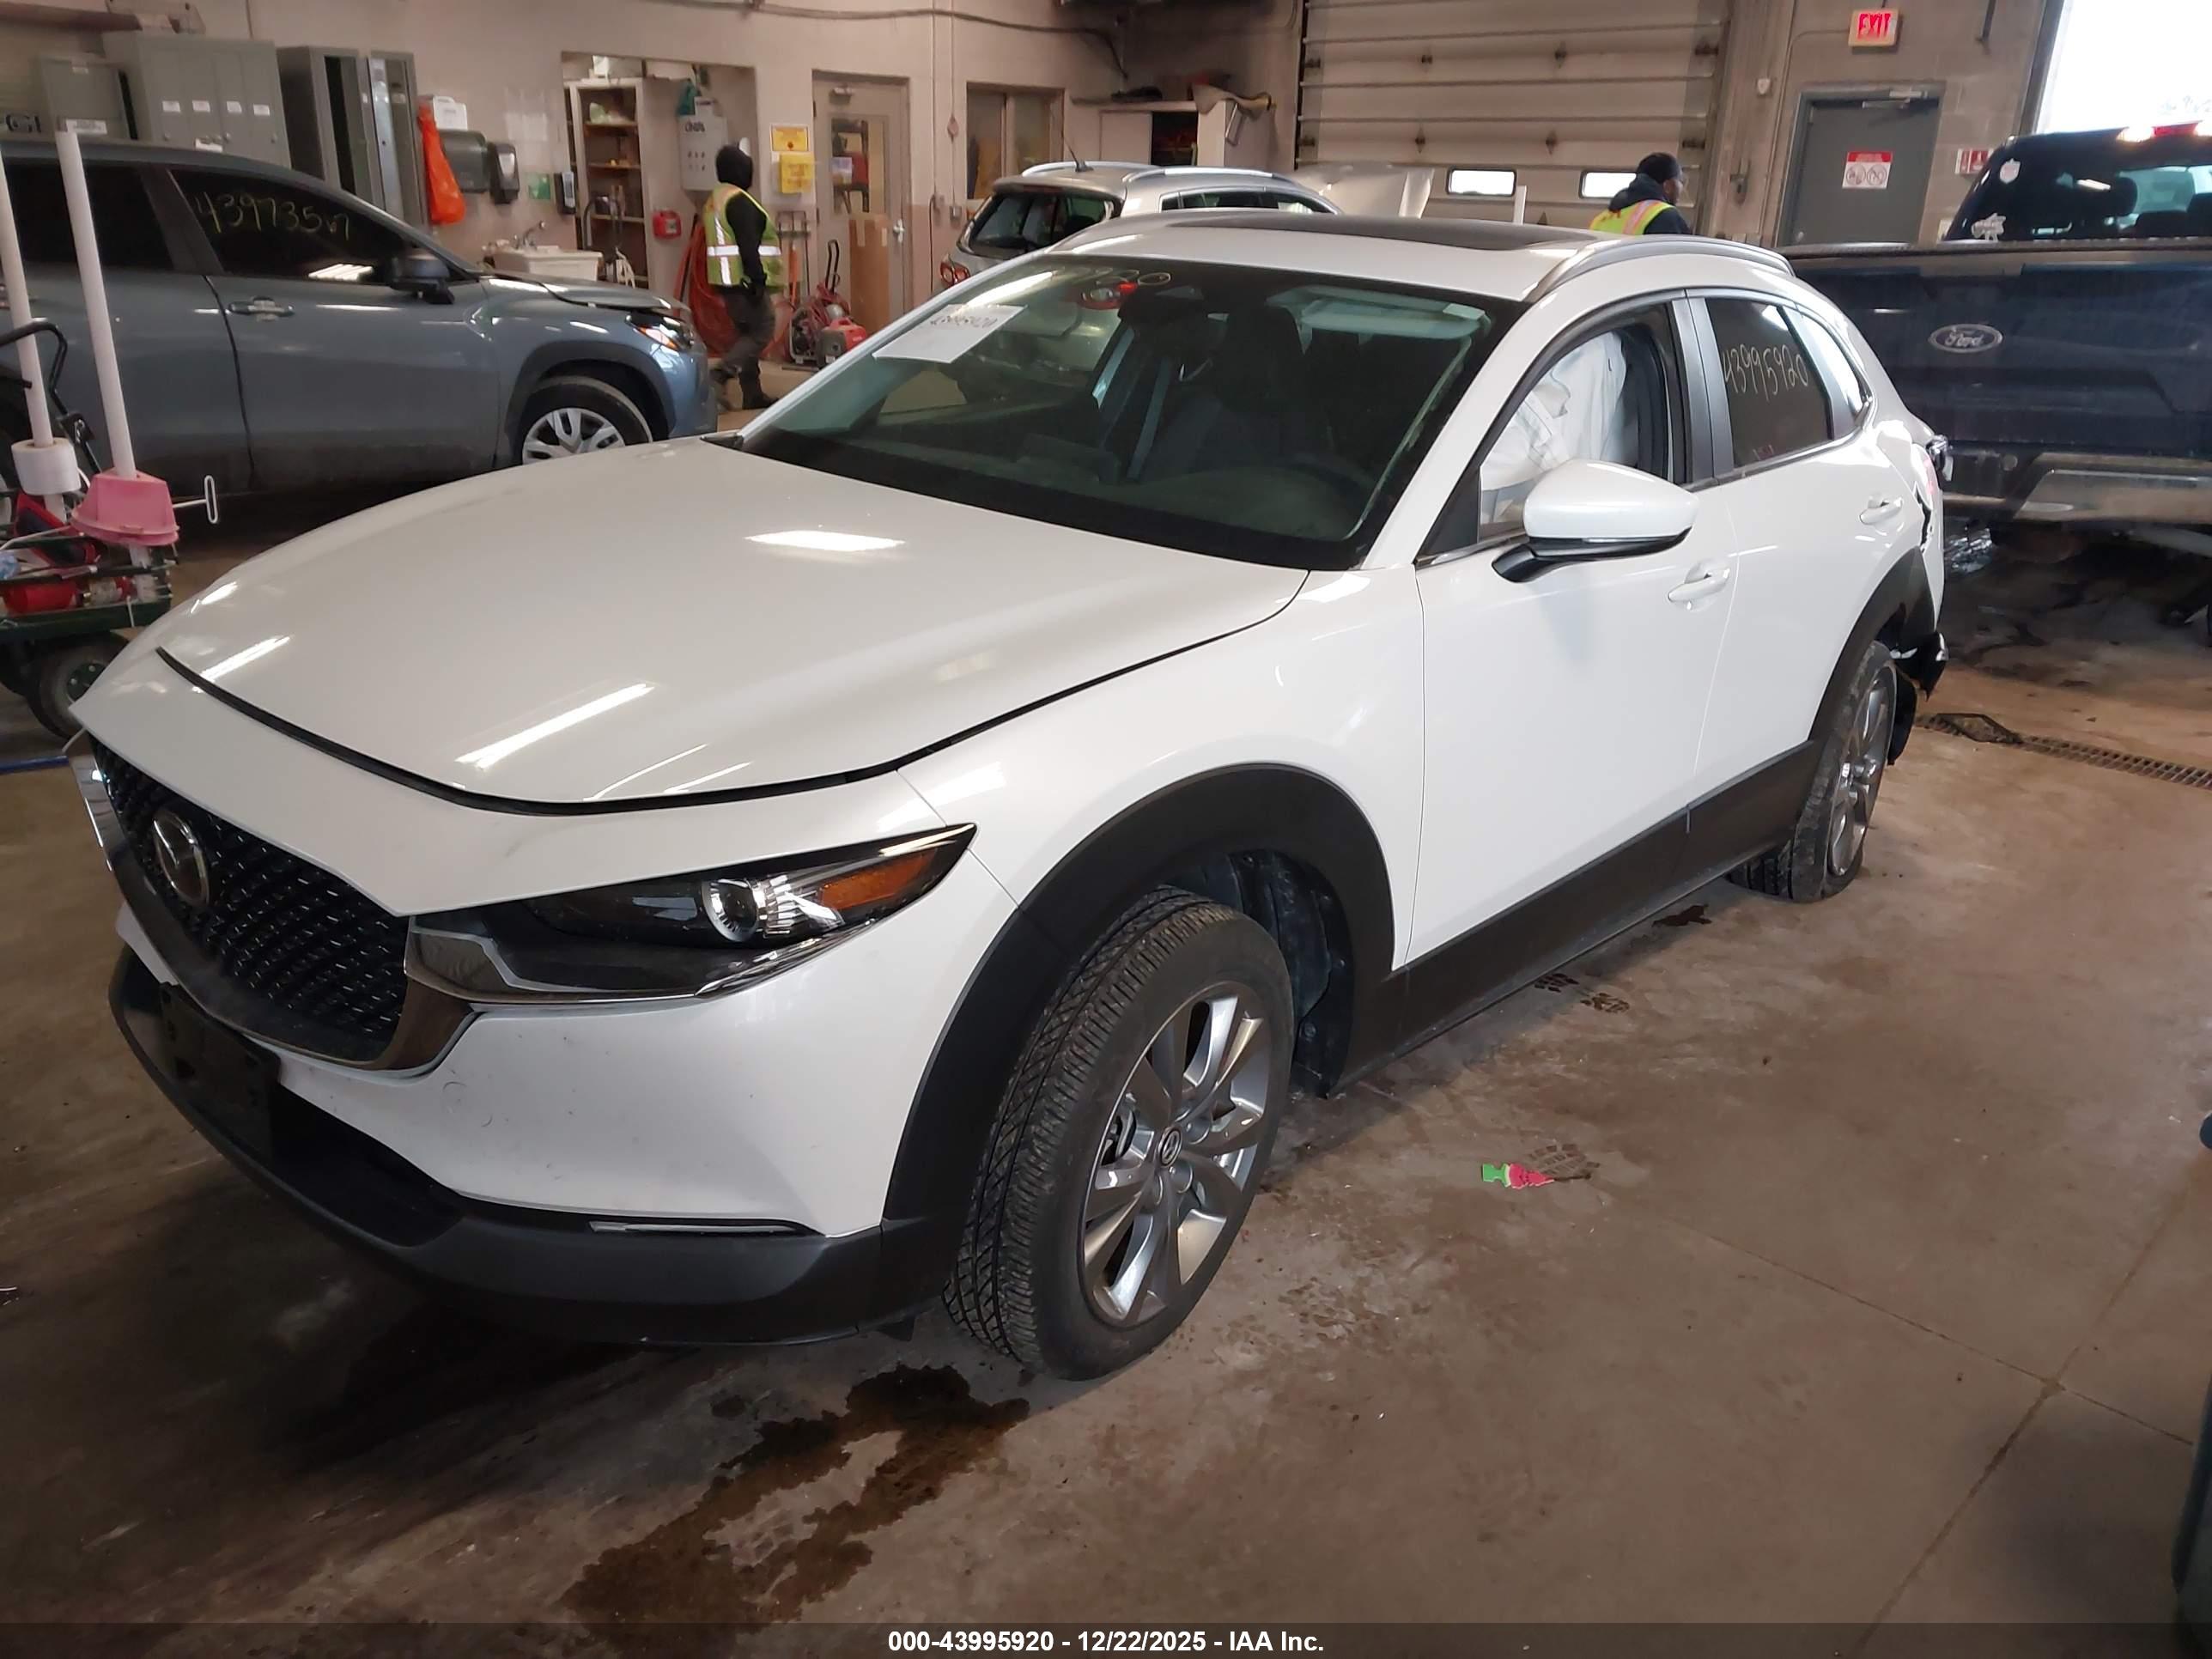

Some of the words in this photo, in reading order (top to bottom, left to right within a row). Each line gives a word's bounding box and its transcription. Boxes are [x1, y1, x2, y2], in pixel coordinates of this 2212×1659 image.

[1857, 13, 1892, 40] EXIT
[1944, 326, 1985, 348] Ford
[1722, 343, 1809, 404] 43995920
